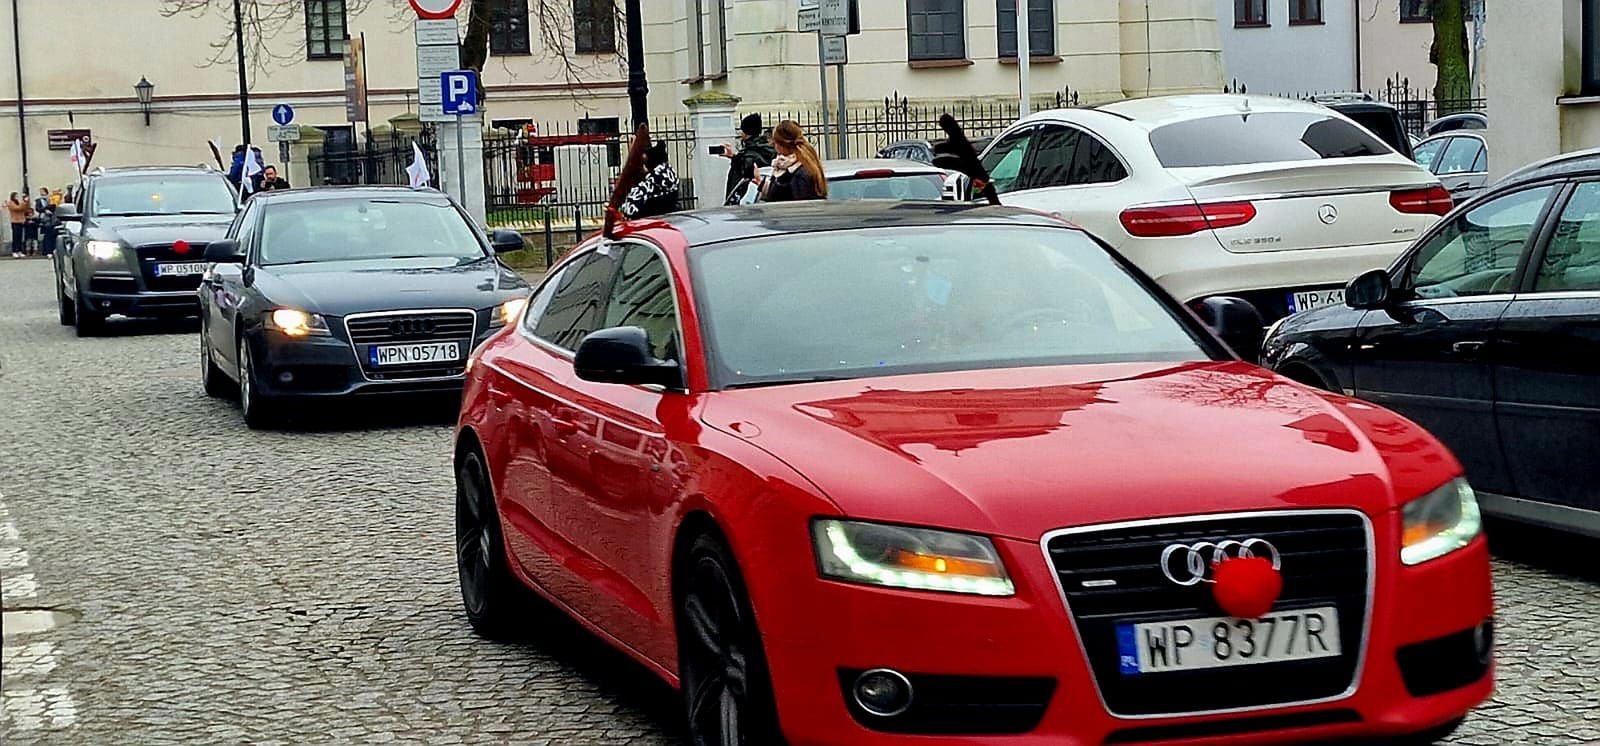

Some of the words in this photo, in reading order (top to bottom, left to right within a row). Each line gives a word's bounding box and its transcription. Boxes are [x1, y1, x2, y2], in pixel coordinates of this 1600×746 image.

[449, 75, 469, 102] P
[160, 264, 174, 273] WP
[1297, 293, 1319, 310] WP
[379, 347, 408, 363] WPN
[412, 344, 457, 361] 05718
[1145, 625, 1194, 668] WP
[1213, 612, 1329, 661] 8377R
